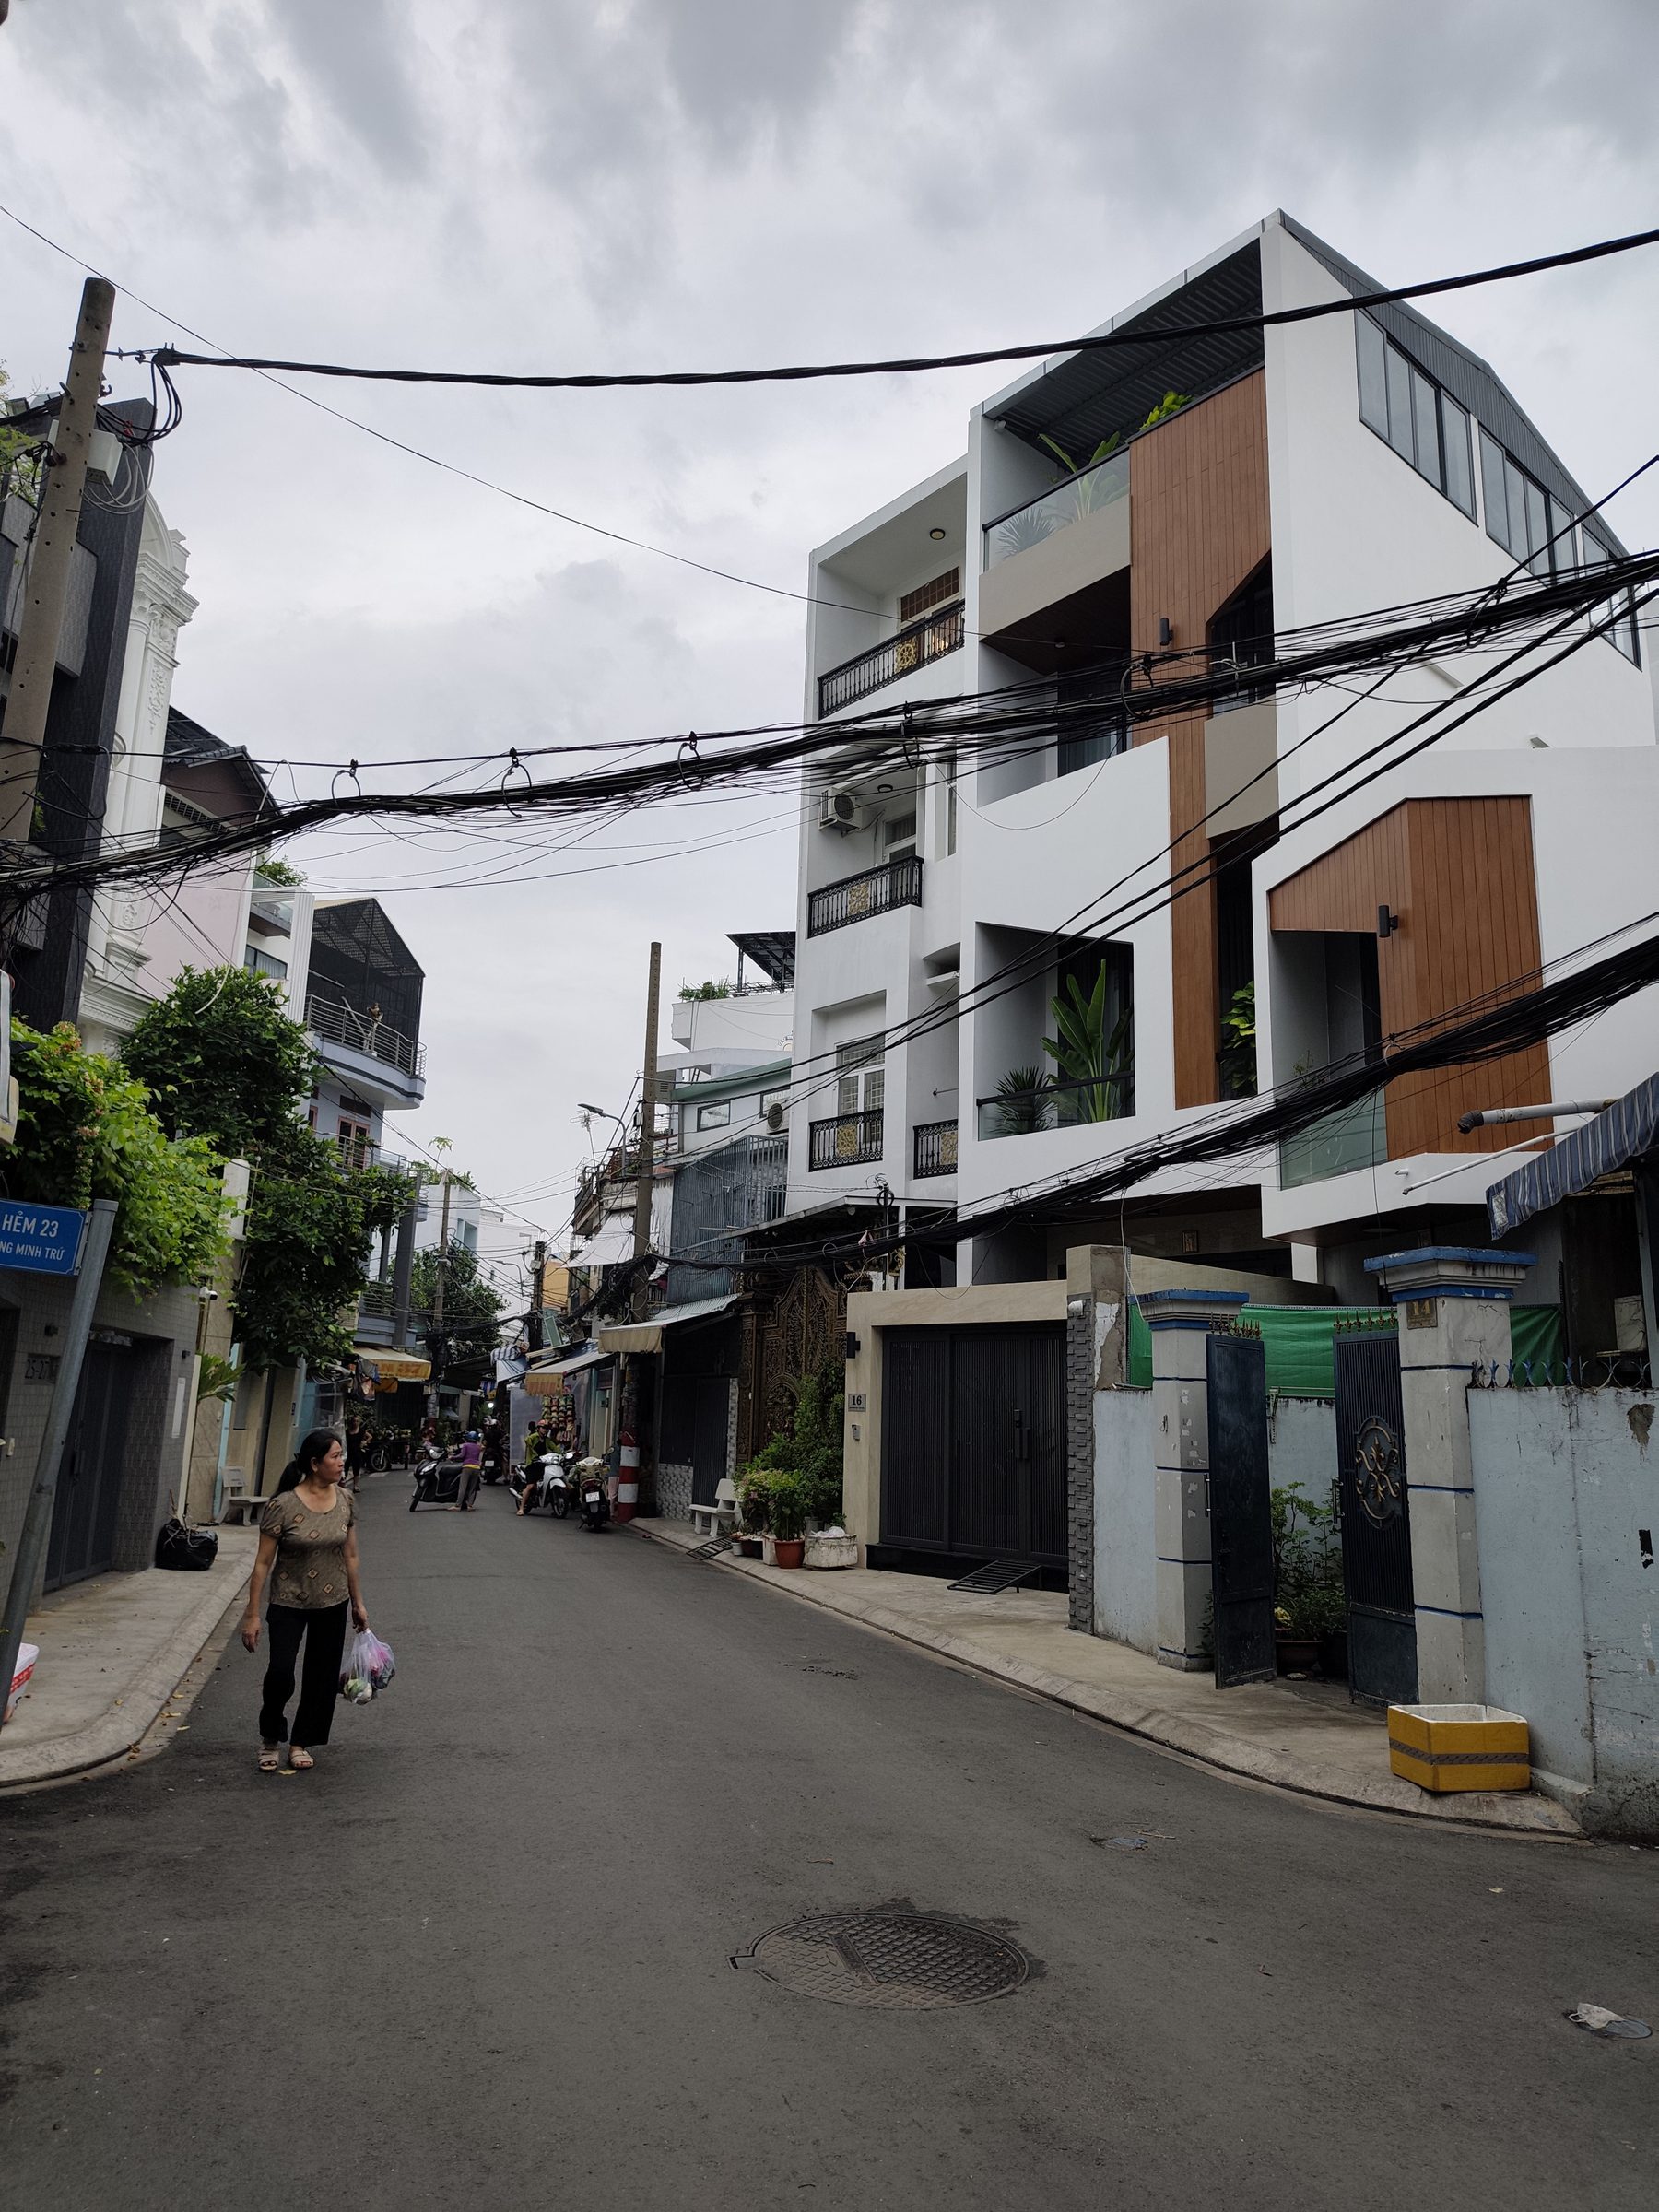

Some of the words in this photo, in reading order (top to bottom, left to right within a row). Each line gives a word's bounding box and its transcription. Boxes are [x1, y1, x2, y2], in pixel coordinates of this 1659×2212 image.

[2, 1210, 37, 1235] HẺM
[40, 1219, 59, 1238] 23
[0, 1241, 14, 1254] NG
[15, 1243, 42, 1258] MINH
[44, 1246, 65, 1261] TRỨ
[1412, 1300, 1430, 1316] 14
[852, 1394, 862, 1406] 16
